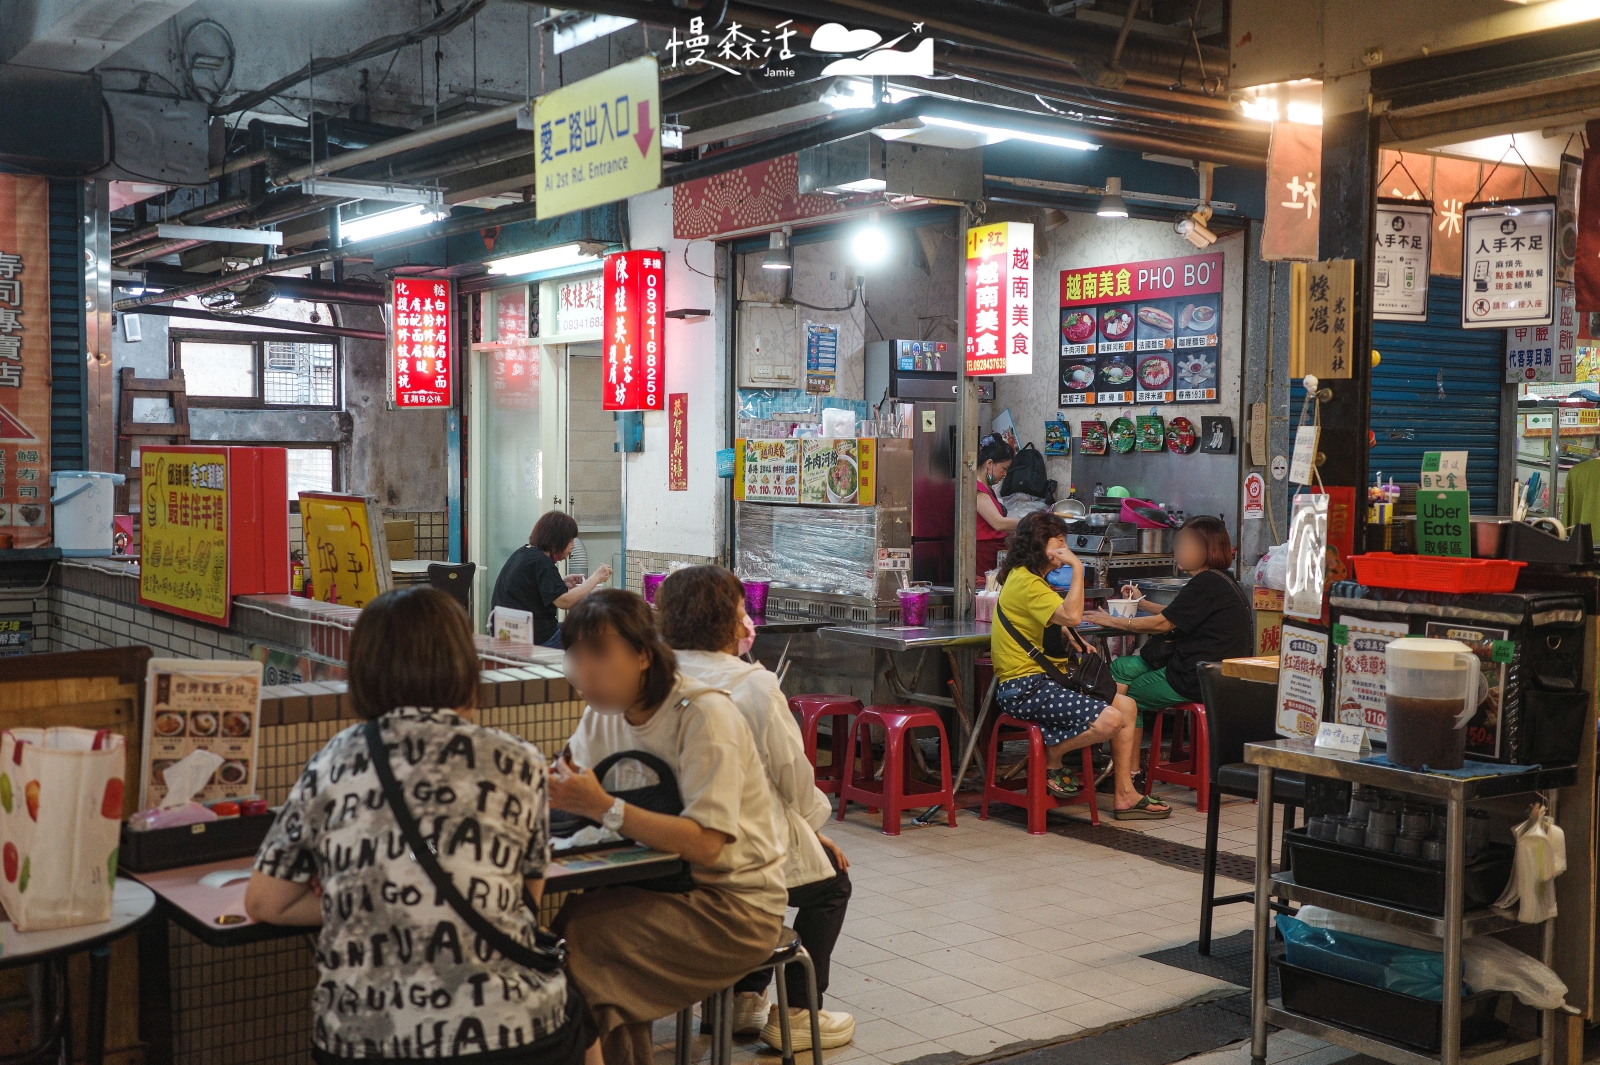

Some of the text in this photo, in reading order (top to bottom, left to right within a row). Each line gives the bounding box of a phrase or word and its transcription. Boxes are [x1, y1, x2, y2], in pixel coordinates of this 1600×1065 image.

[541, 95, 630, 164] 愛二路出入口
[545, 175, 553, 192] Ai
[556, 172, 569, 189] 2st
[589, 156, 628, 179] Entrance
[968, 231, 1004, 251] 小紅
[1476, 235, 1543, 254] 人手不足
[643, 258, 661, 270] 手機
[1496, 260, 1523, 269] 麻煩先
[1066, 268, 1132, 301] 越南美食
[1138, 266, 1175, 291] PHO
[1496, 281, 1532, 291] 現金結帳
[975, 260, 999, 357] 越南美食
[1012, 247, 1029, 355] 越南美食
[1493, 300, 1542, 310] 請勿接入座
[647, 274, 657, 406] 0934168256
[1509, 348, 1551, 368] 代客穿耳洞
[403, 395, 442, 404] 星期日公休
[804, 450, 838, 472] 牛肉河粉
[1423, 473, 1458, 490] 自己拿
[168, 491, 223, 531] 最佳伴手禮
[1423, 504, 1461, 519] Uber
[1424, 521, 1462, 536] Eats
[1424, 541, 1462, 555] 取餐區
[1261, 625, 1280, 653] 辣
[1356, 640, 1385, 651] 冷凍真空
[1284, 653, 1323, 679] 紅酒燉牛肉
